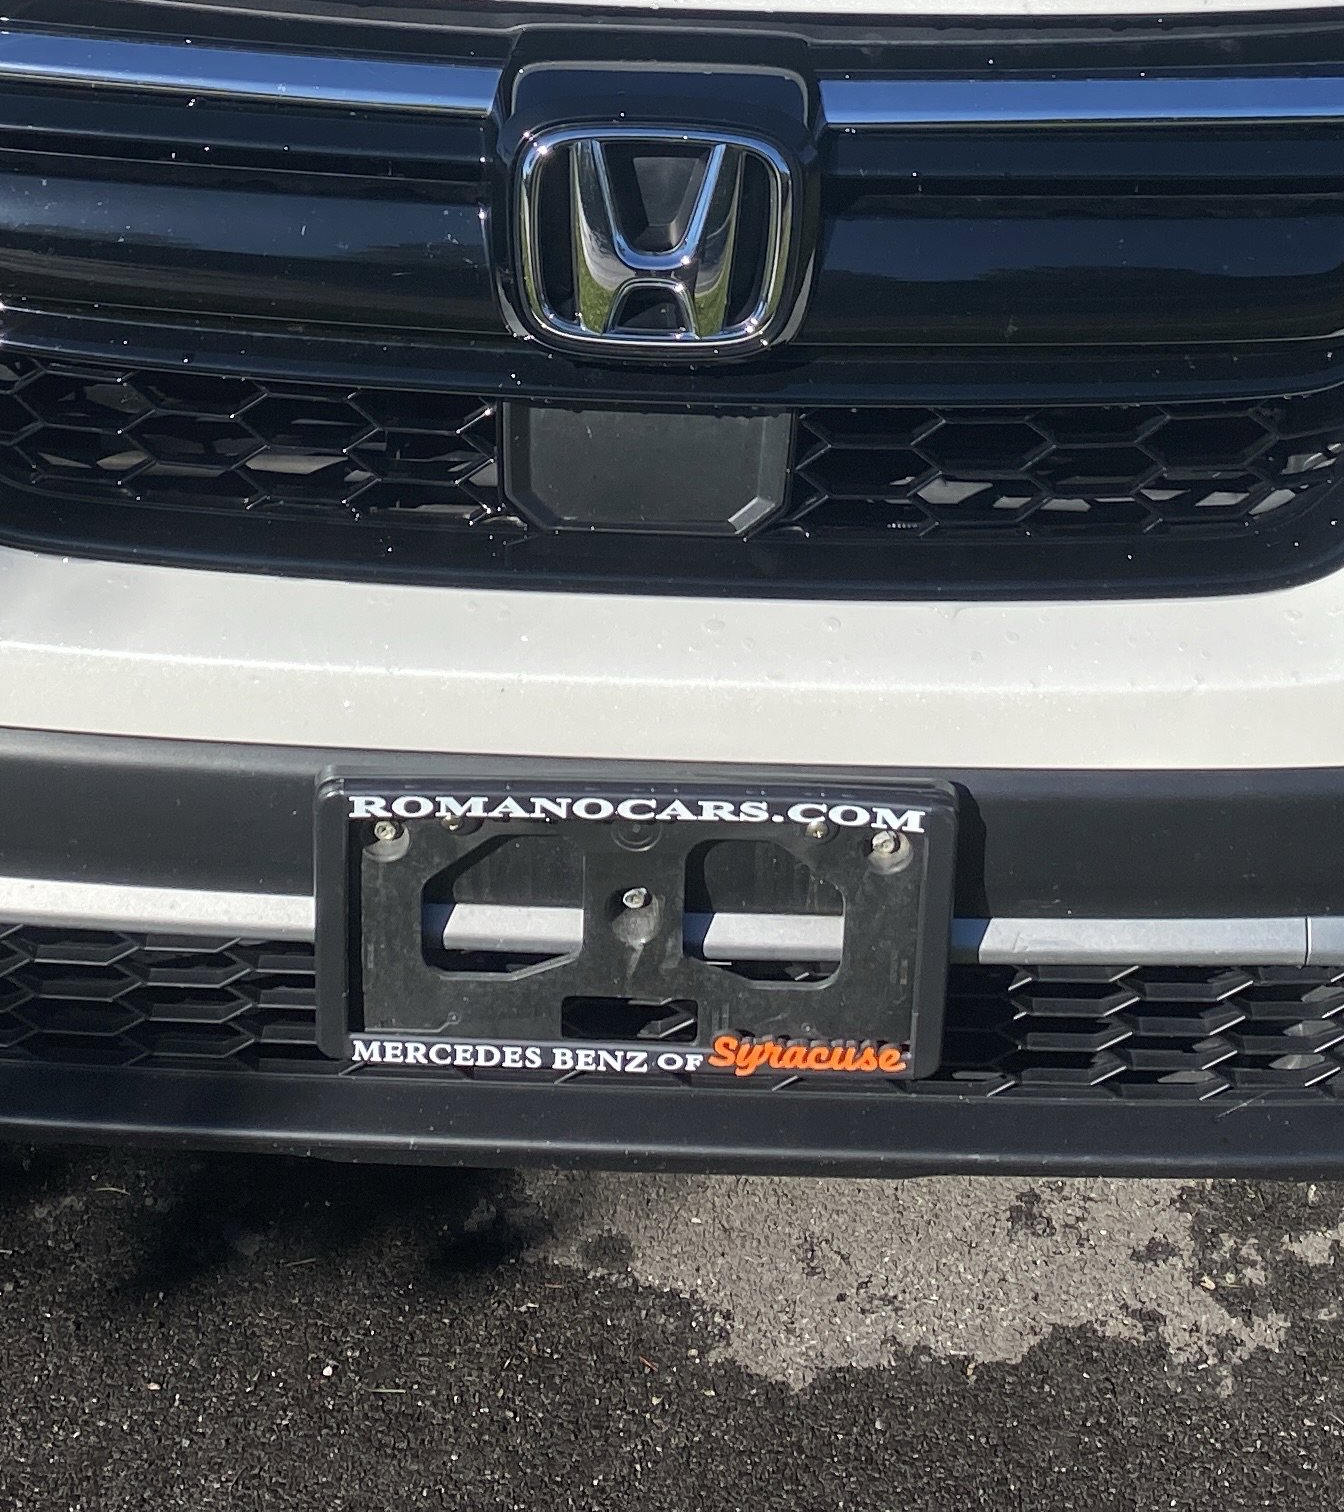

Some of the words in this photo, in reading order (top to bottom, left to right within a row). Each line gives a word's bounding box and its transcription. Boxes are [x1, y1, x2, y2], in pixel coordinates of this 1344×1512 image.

[348, 795, 926, 834] ROMANOCARS.COM
[351, 1040, 543, 1069] MERCEDES
[552, 1047, 648, 1072] BENZ
[656, 1052, 704, 1072] OF
[707, 1033, 907, 1077] Syracuse
